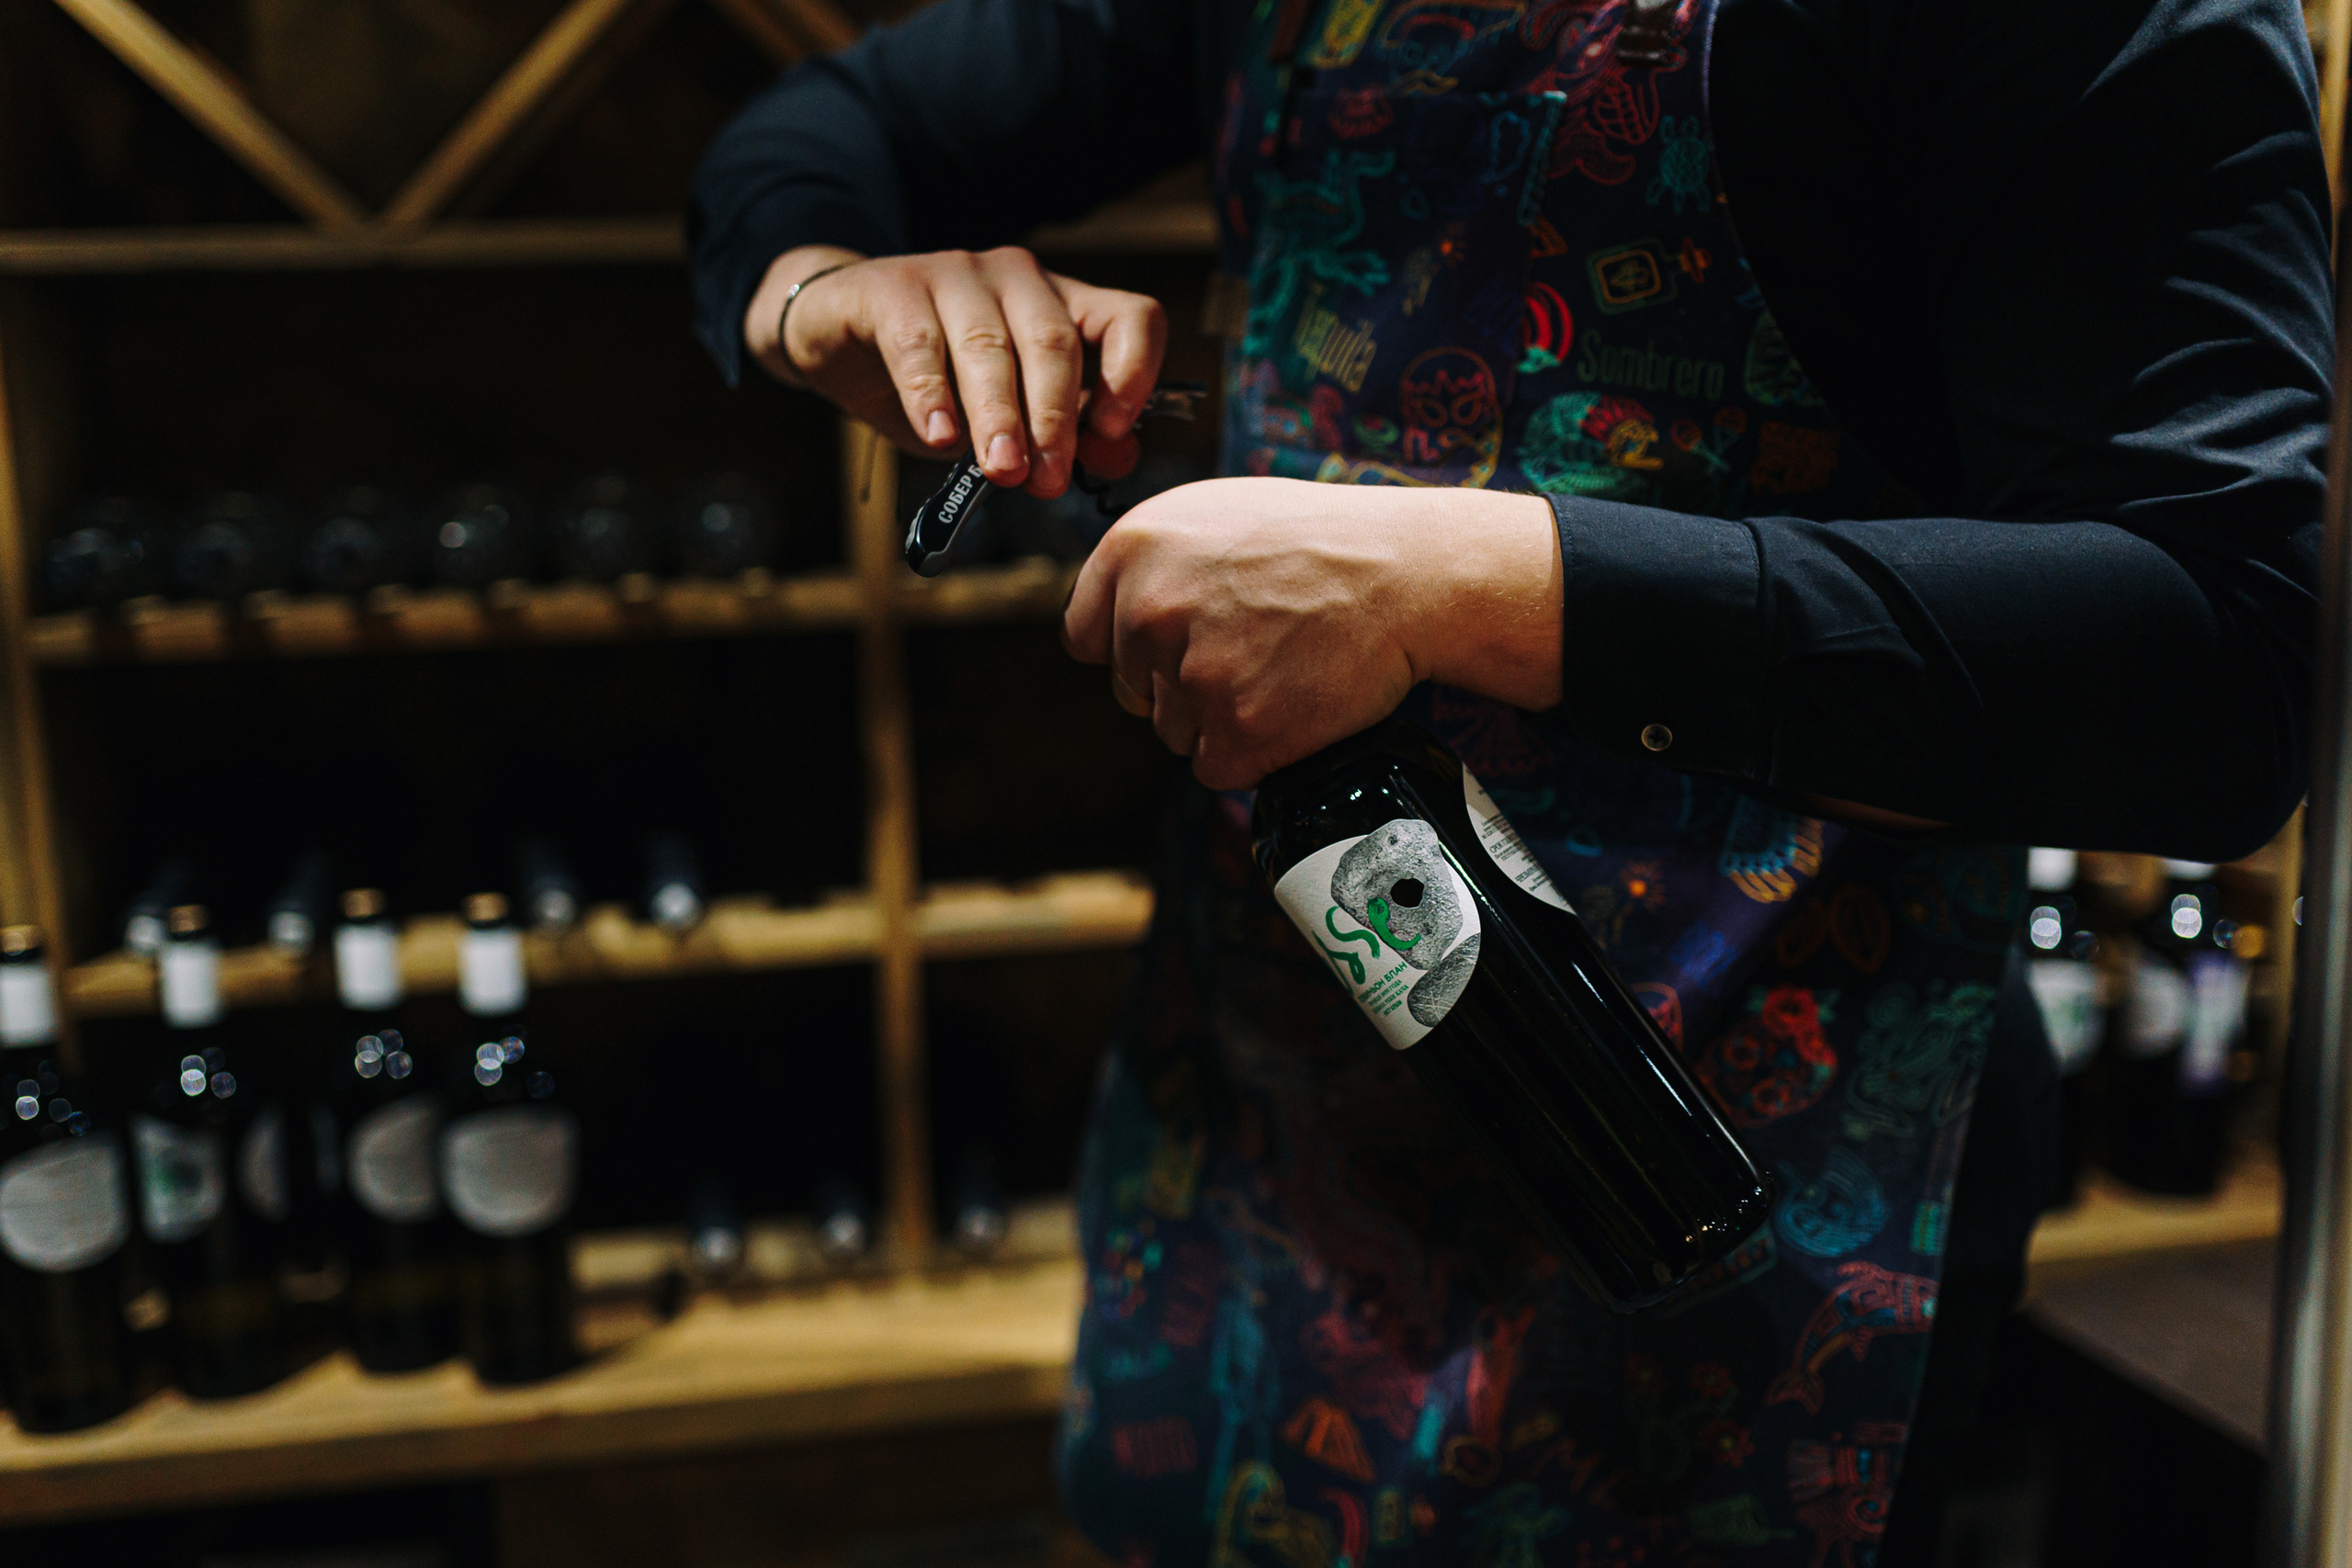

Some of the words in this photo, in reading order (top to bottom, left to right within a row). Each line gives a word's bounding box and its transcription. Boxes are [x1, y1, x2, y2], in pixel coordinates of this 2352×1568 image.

[1577, 327, 1725, 401] Sombrero
[938, 474, 973, 525] СОБЕР
[967, 464, 983, 478] Б
[1384, 961, 1408, 982] БЛАН
